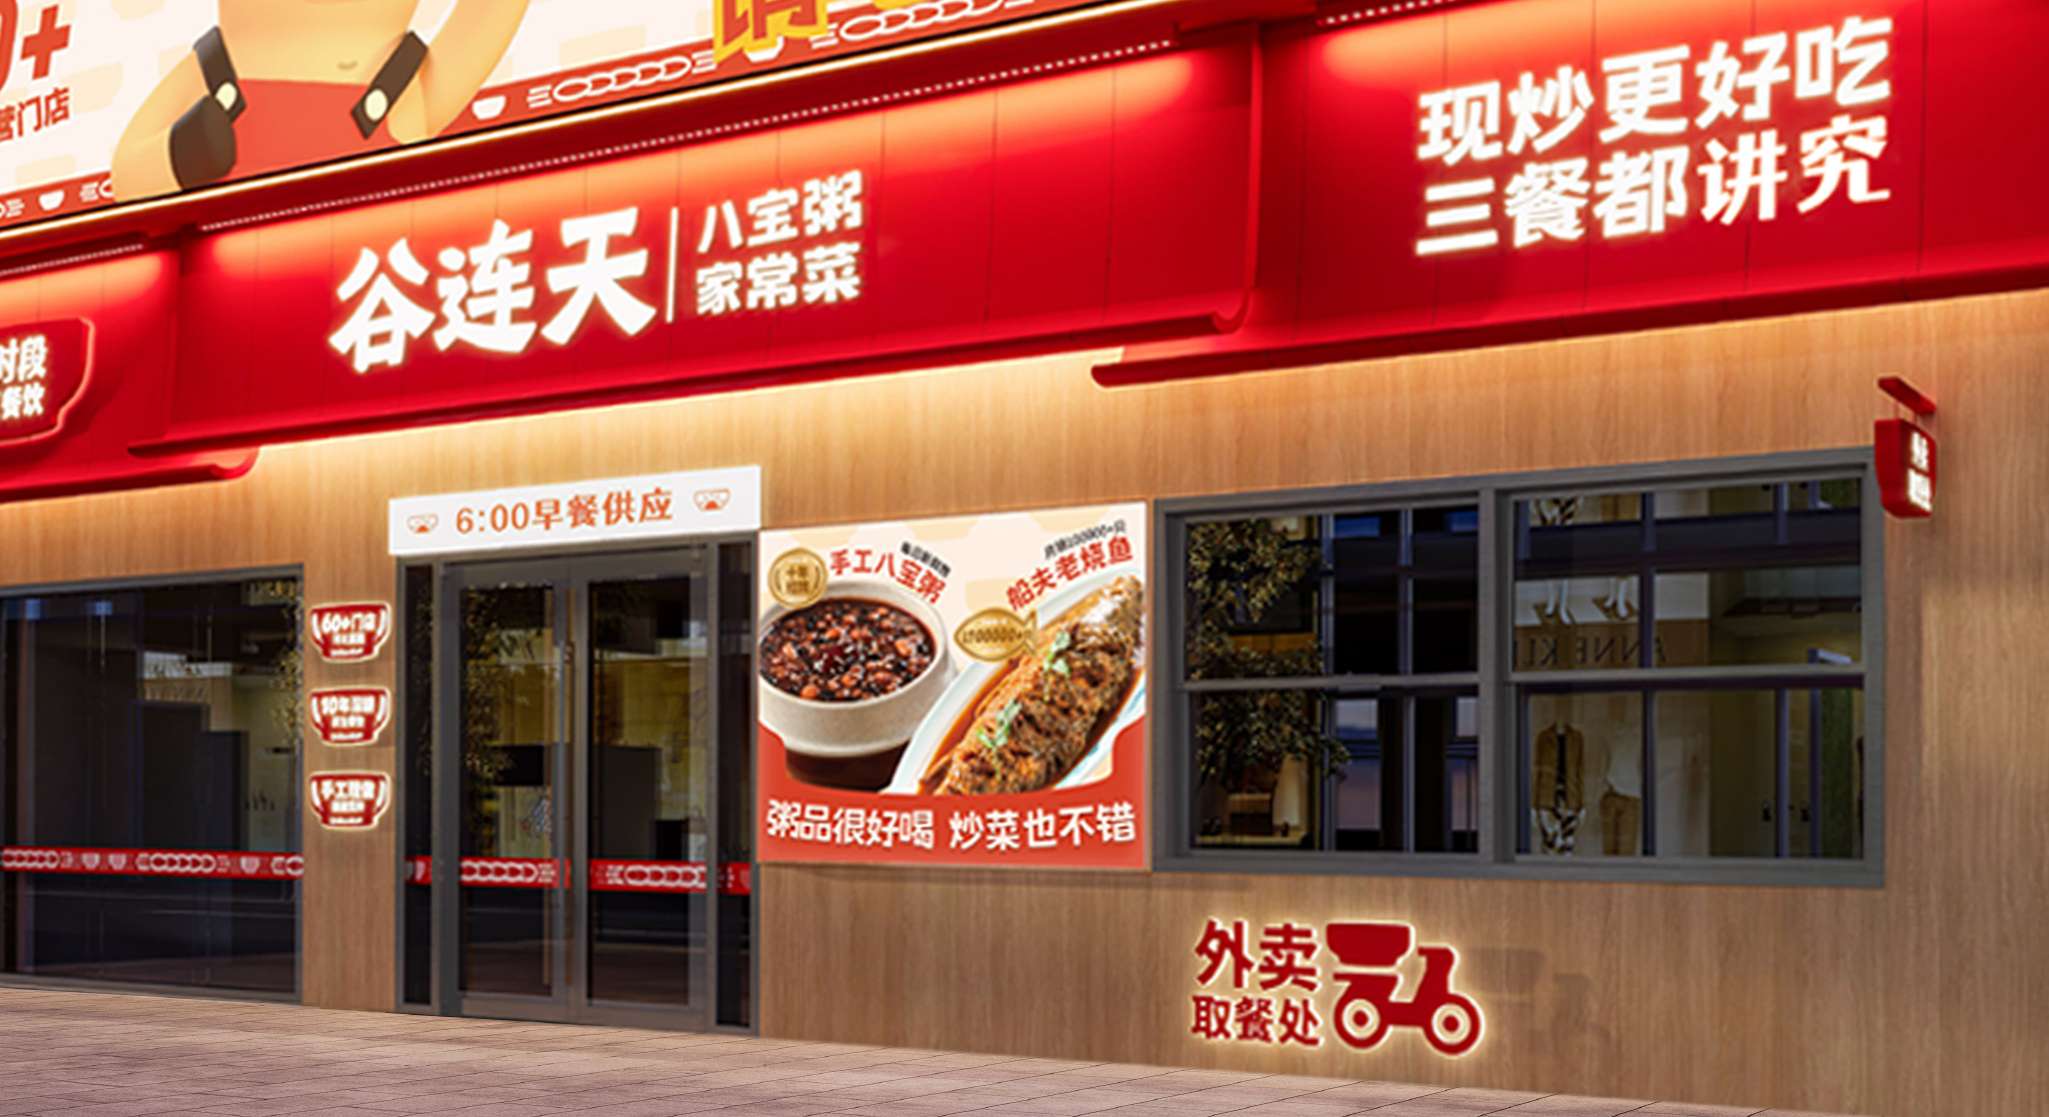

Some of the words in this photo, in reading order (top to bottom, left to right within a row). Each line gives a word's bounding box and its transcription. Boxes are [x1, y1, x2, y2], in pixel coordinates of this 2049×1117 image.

[1416, 16, 1893, 166] 现炒更好吃
[697, 169, 864, 253] 八宝粥
[1416, 116, 1892, 256] 三餐都讲究
[328, 206, 657, 375] 谷连天
[696, 242, 862, 317] 家常菜
[455, 486, 674, 535] 6:00早餐供应
[829, 549, 947, 604] 手工八宝粥
[1006, 535, 1134, 611] 船夫老烧鱼
[766, 799, 935, 850] 粥品很好喝
[949, 801, 1137, 852] 炒菜也不错
[1194, 919, 1319, 992] 外卖
[1191, 994, 1323, 1048] 取餐处
